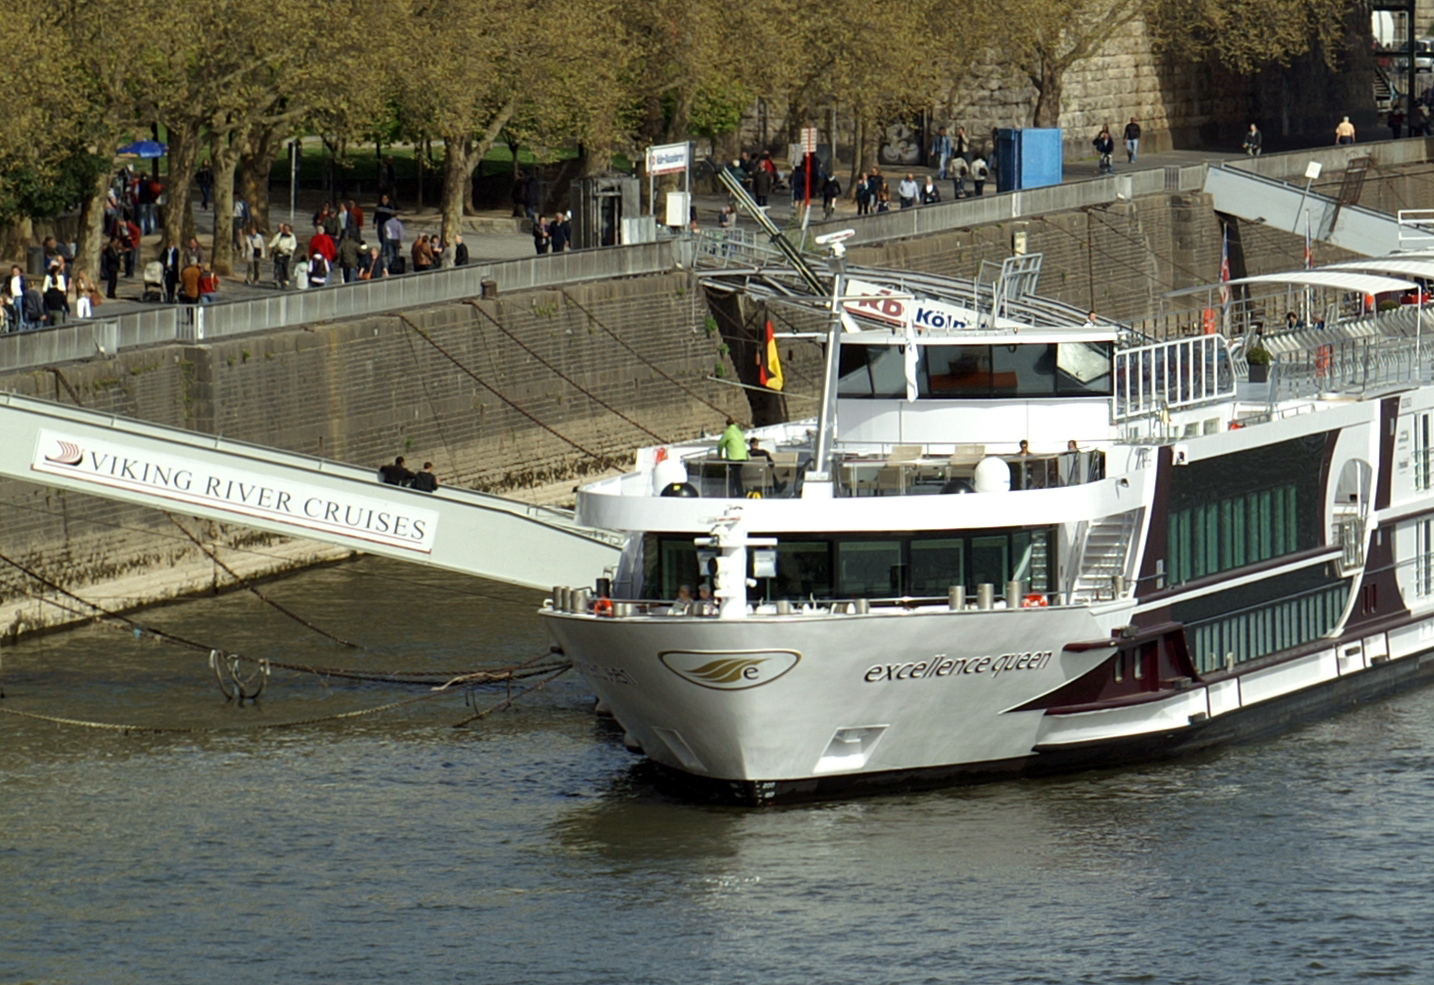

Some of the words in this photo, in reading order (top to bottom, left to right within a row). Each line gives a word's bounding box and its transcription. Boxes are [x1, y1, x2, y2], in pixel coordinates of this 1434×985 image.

[88, 450, 193, 491] VIKING
[205, 475, 292, 512] RIVER
[303, 496, 427, 541] CRUISES
[743, 666, 760, 681] e
[863, 653, 992, 683] excellence
[990, 649, 1053, 679] queen
